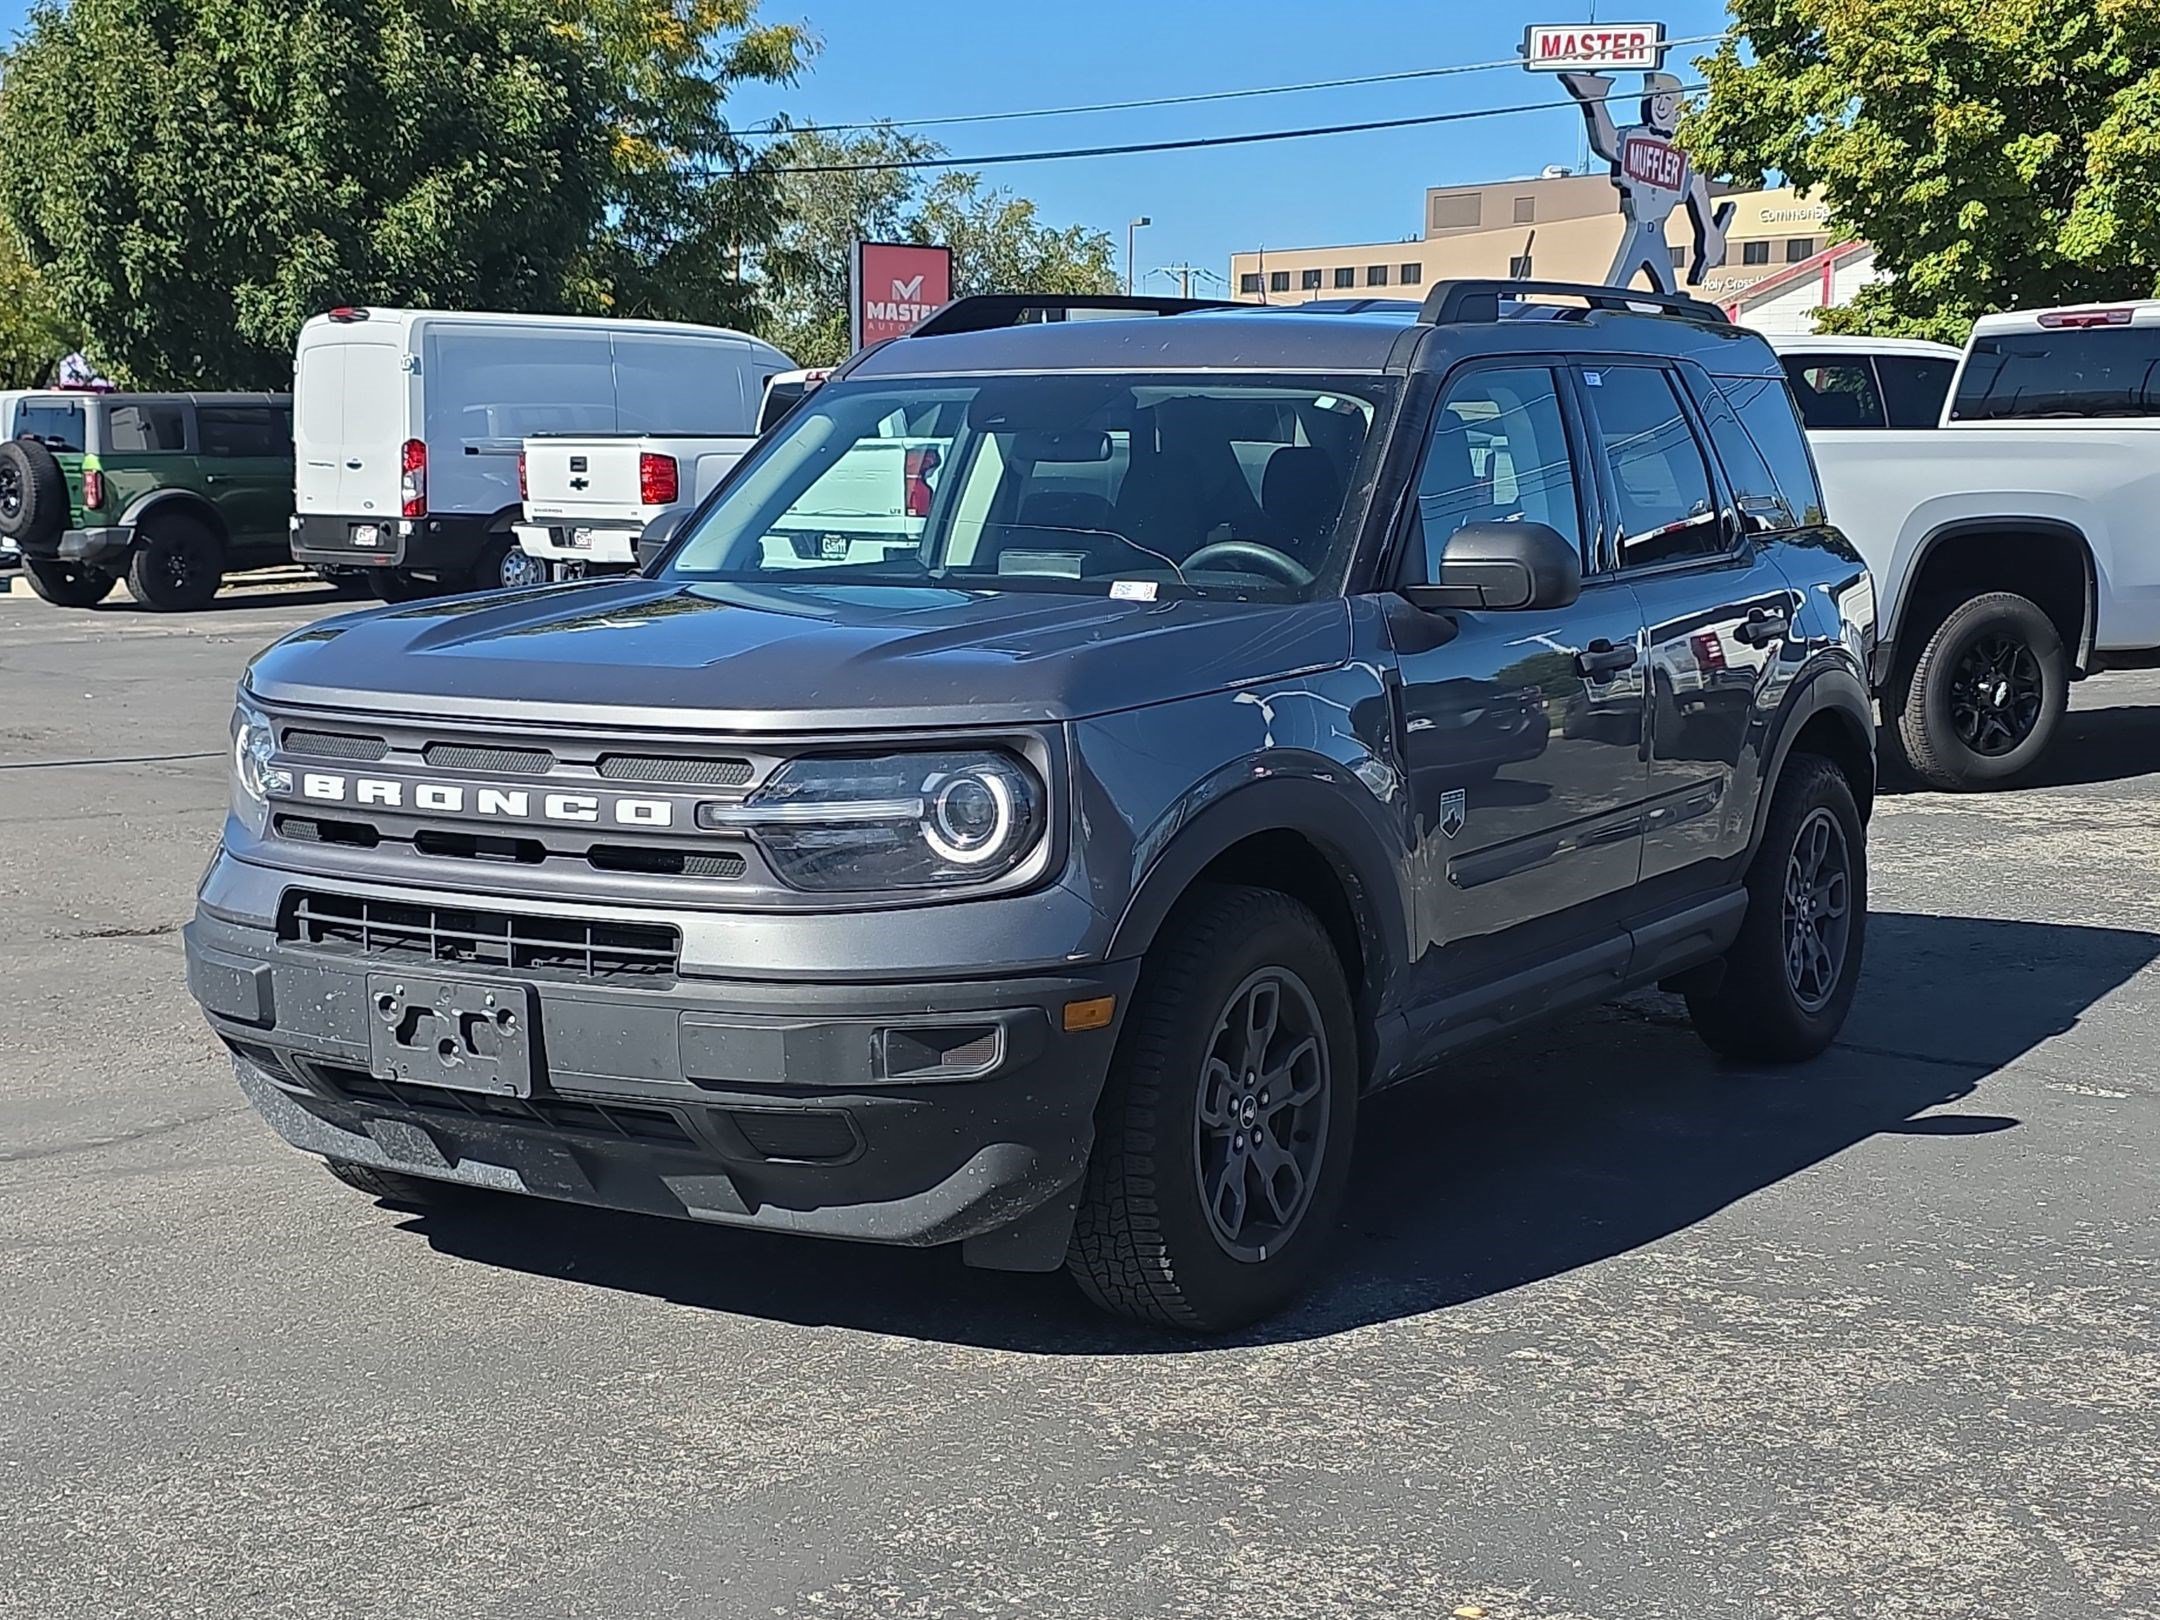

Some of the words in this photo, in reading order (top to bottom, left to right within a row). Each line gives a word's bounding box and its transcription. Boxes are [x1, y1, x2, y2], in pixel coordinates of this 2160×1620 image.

[1541, 33, 1645, 60] MASTER
[1630, 143, 1680, 185] MUFFLER
[1701, 276, 1723, 292] Holy
[1726, 276, 1754, 290] Cross
[867, 301, 939, 322] MASTE
[303, 773, 673, 827] BRONCO
